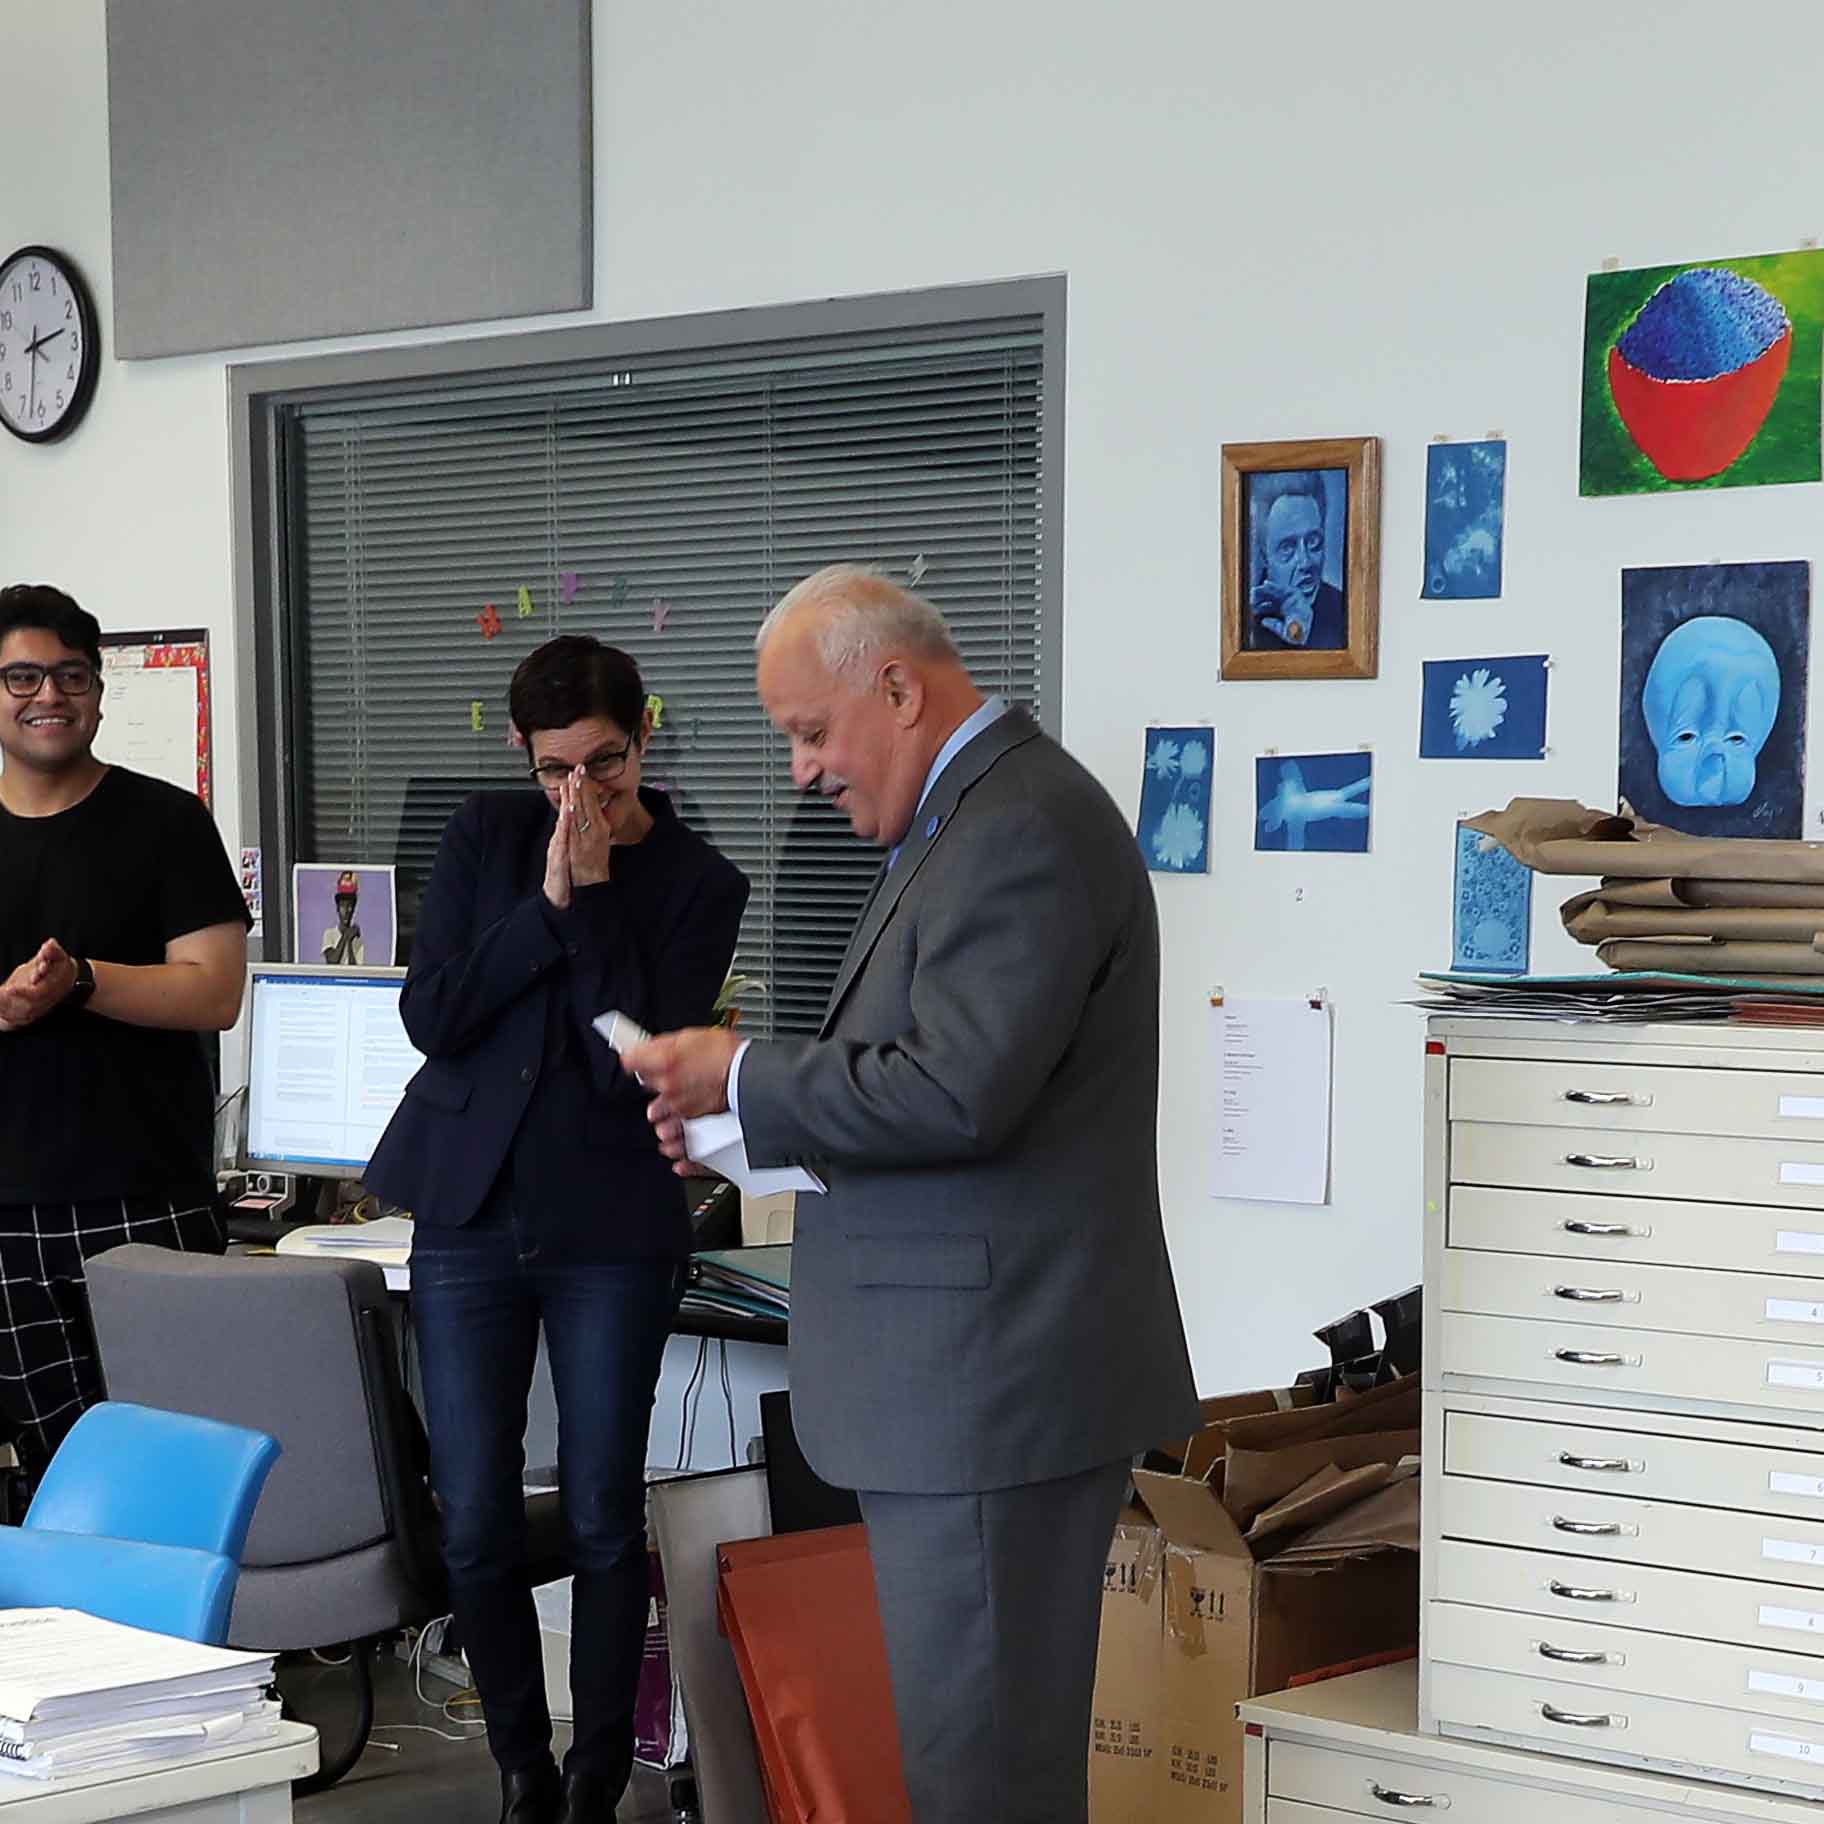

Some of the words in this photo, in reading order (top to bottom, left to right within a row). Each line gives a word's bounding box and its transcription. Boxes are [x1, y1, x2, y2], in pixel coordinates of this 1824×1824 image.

[29, 272, 41, 292] 12
[50, 277, 57, 296] 1
[12, 283, 23, 303] 11
[65, 300, 73, 320] 2
[0, 311, 13, 331] 10
[70, 332, 79, 352] 3
[5, 372, 13, 391] 8
[65, 363, 74, 381] 4
[18, 395, 26, 414] 7
[37, 399, 46, 419] 6
[55, 390, 64, 409] 5
[1819, 812, 1824, 824] 4
[1296, 889, 1302, 901] 2
[1800, 1745, 1810, 1754] 10
